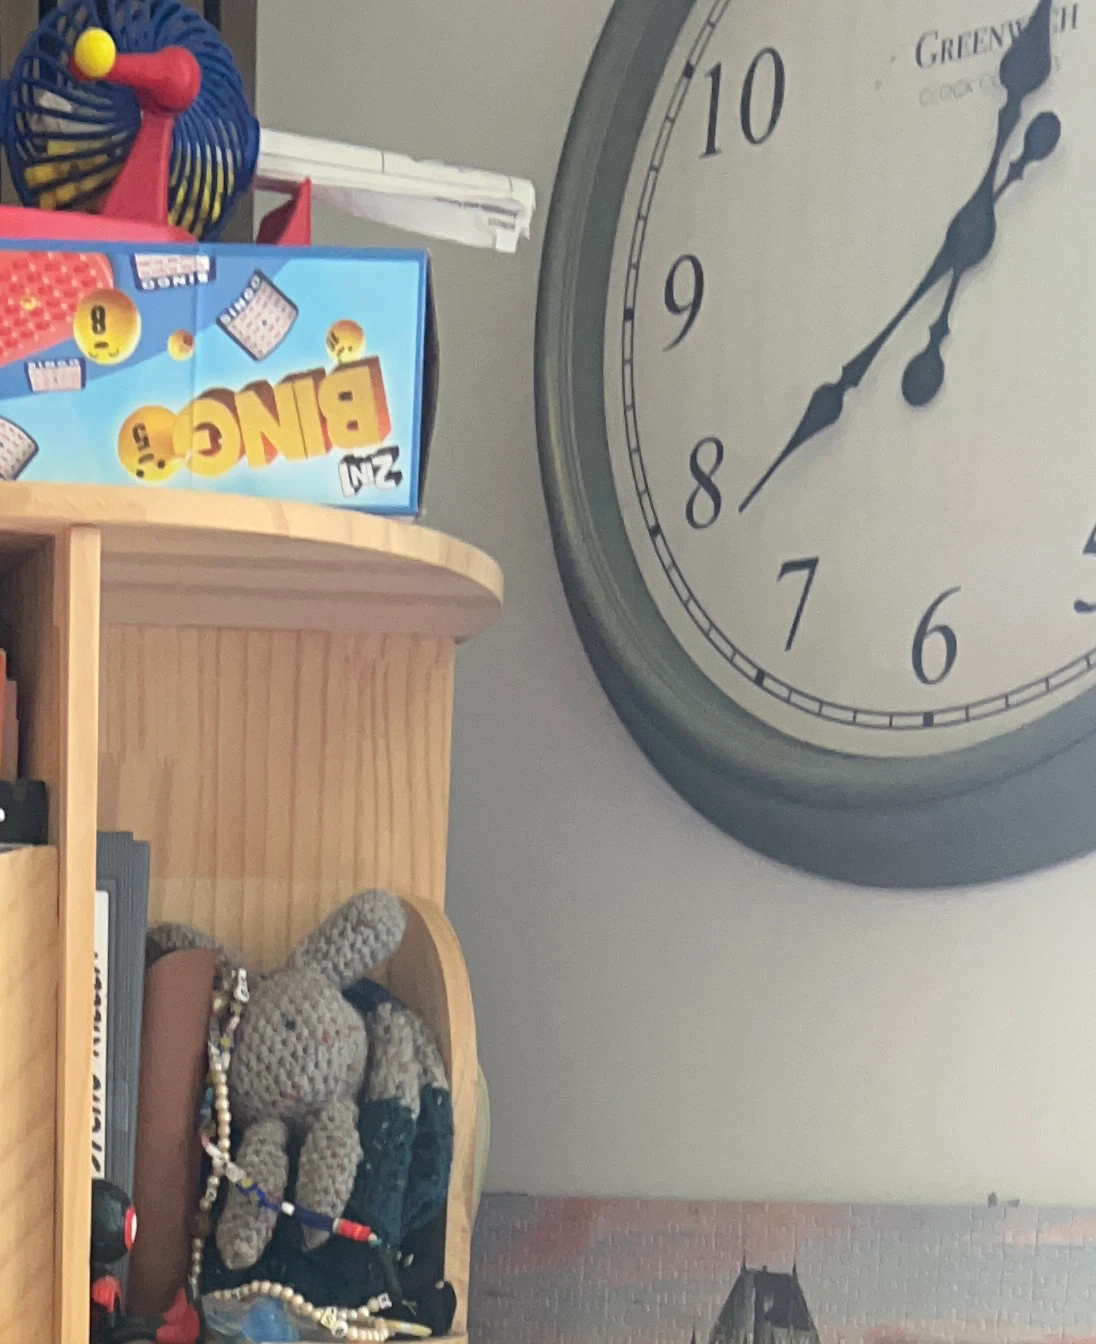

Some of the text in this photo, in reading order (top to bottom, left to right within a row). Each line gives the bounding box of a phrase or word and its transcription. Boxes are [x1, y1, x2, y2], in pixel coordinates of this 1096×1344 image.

[699, 47, 785, 159] 10
[663, 253, 704, 353] 9
[685, 436, 724, 530] 8
[777, 555, 820, 651] 7
[910, 586, 962, 685] 6
